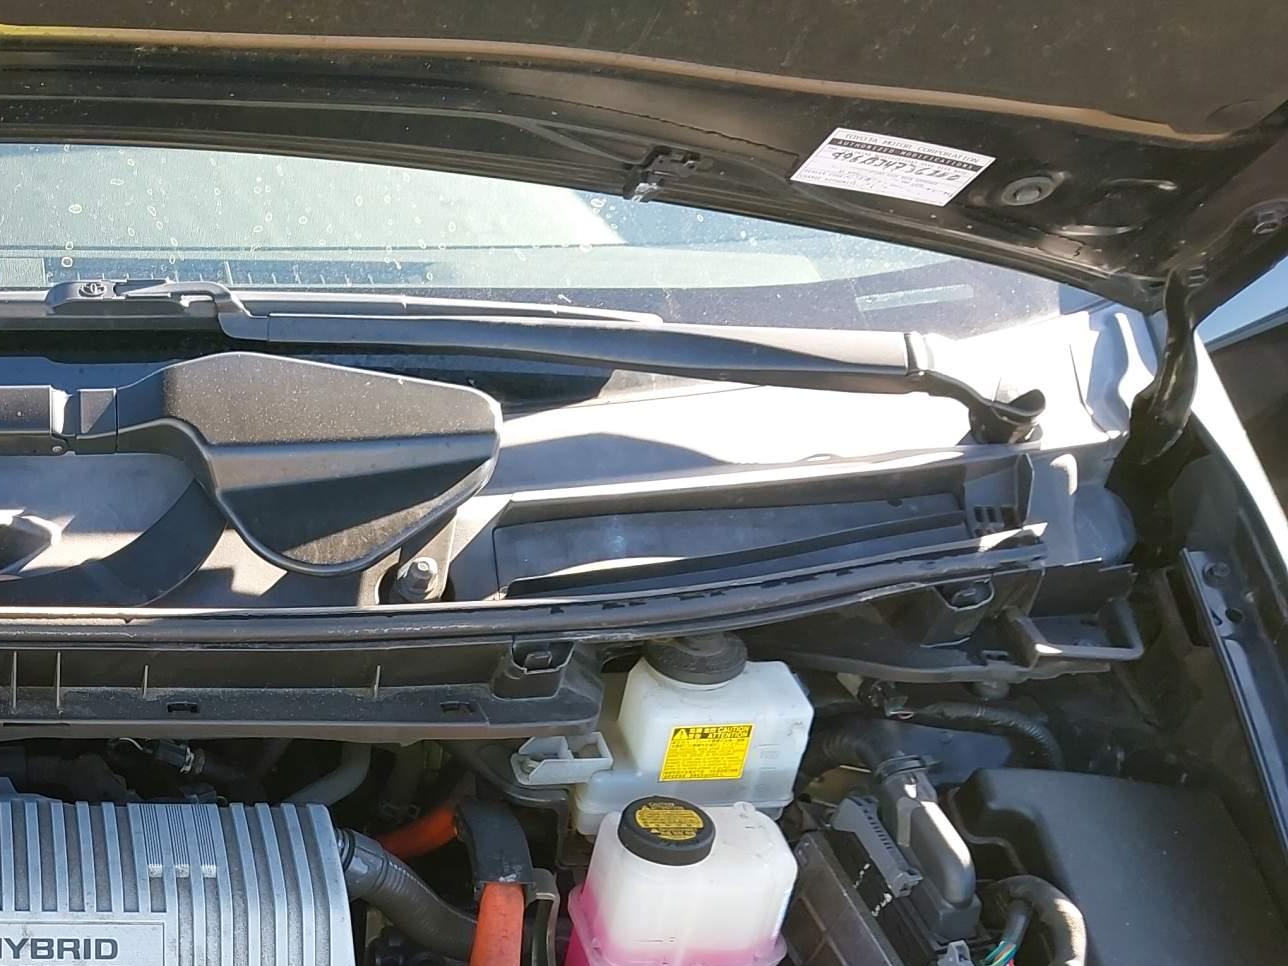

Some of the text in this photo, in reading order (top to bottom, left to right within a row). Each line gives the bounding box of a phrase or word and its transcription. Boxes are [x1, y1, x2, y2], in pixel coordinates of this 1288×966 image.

[837, 139, 895, 155] AUTHORIZED
[899, 150, 975, 171] MODIFICATIONS
[844, 133, 981, 163] TOYOTA MOTOR CORPORATION
[708, 731, 749, 739] ATTENTION
